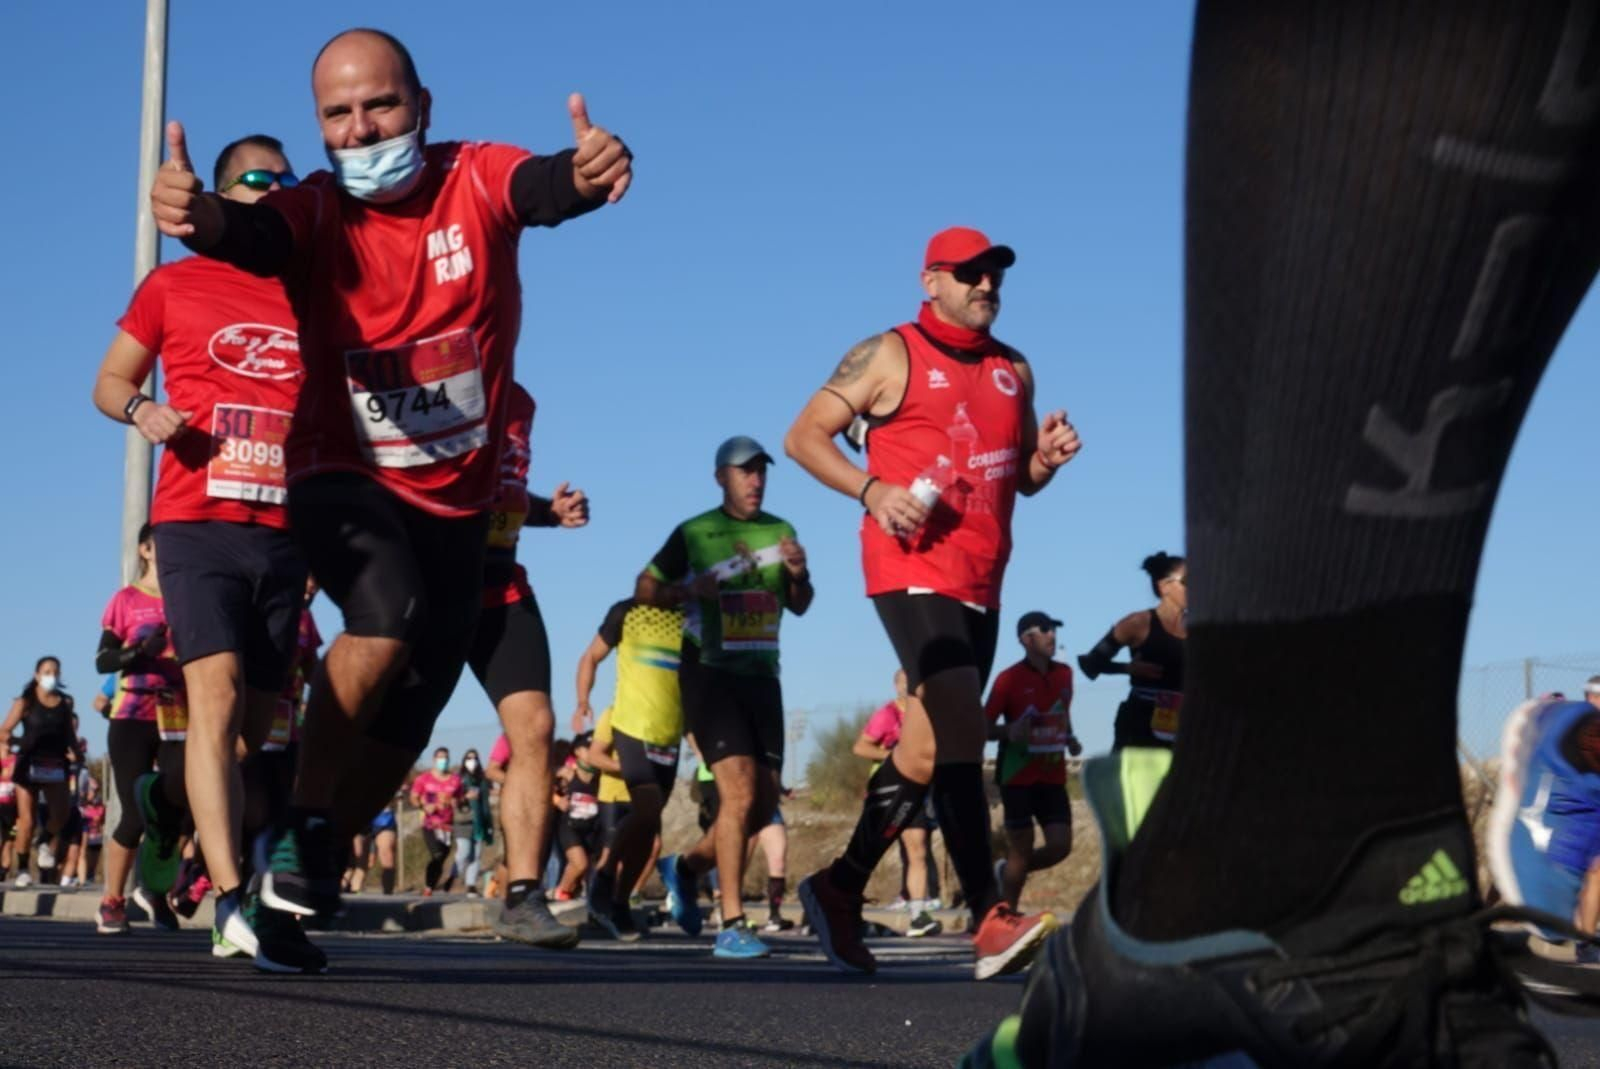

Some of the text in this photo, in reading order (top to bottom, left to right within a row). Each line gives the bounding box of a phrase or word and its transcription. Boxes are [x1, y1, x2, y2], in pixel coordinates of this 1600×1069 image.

[427, 223, 464, 260] MG
[367, 382, 450, 422] 9744
[216, 408, 252, 438] 30
[220, 438, 284, 467] 3099
